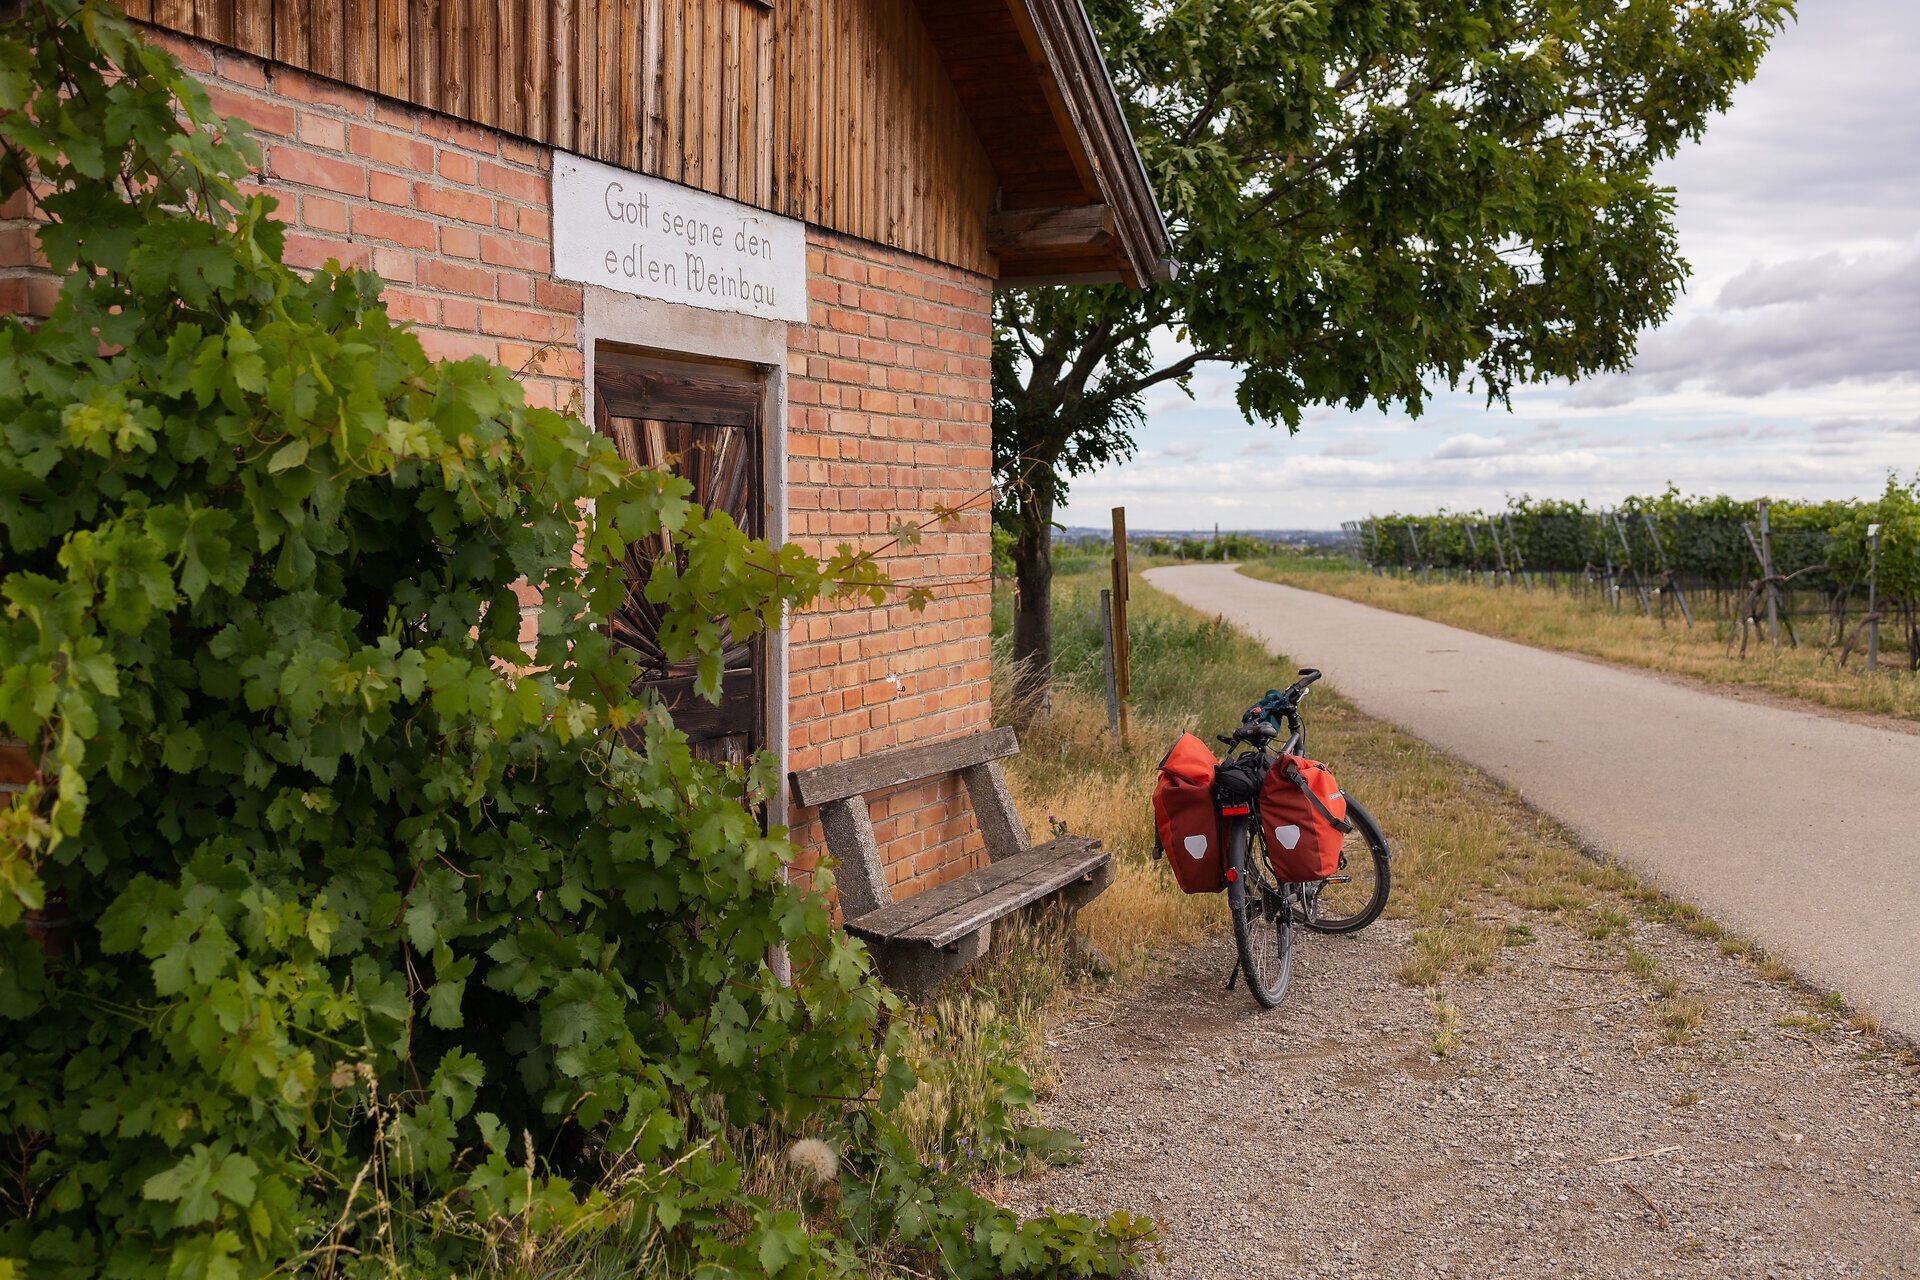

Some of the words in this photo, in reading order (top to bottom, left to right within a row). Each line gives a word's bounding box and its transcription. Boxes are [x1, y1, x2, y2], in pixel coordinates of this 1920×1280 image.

[605, 182, 650, 228] Gott
[662, 211, 723, 246] segne
[734, 222, 772, 261] den
[605, 243, 676, 286] edlen
[685, 252, 776, 307] Weinbau
